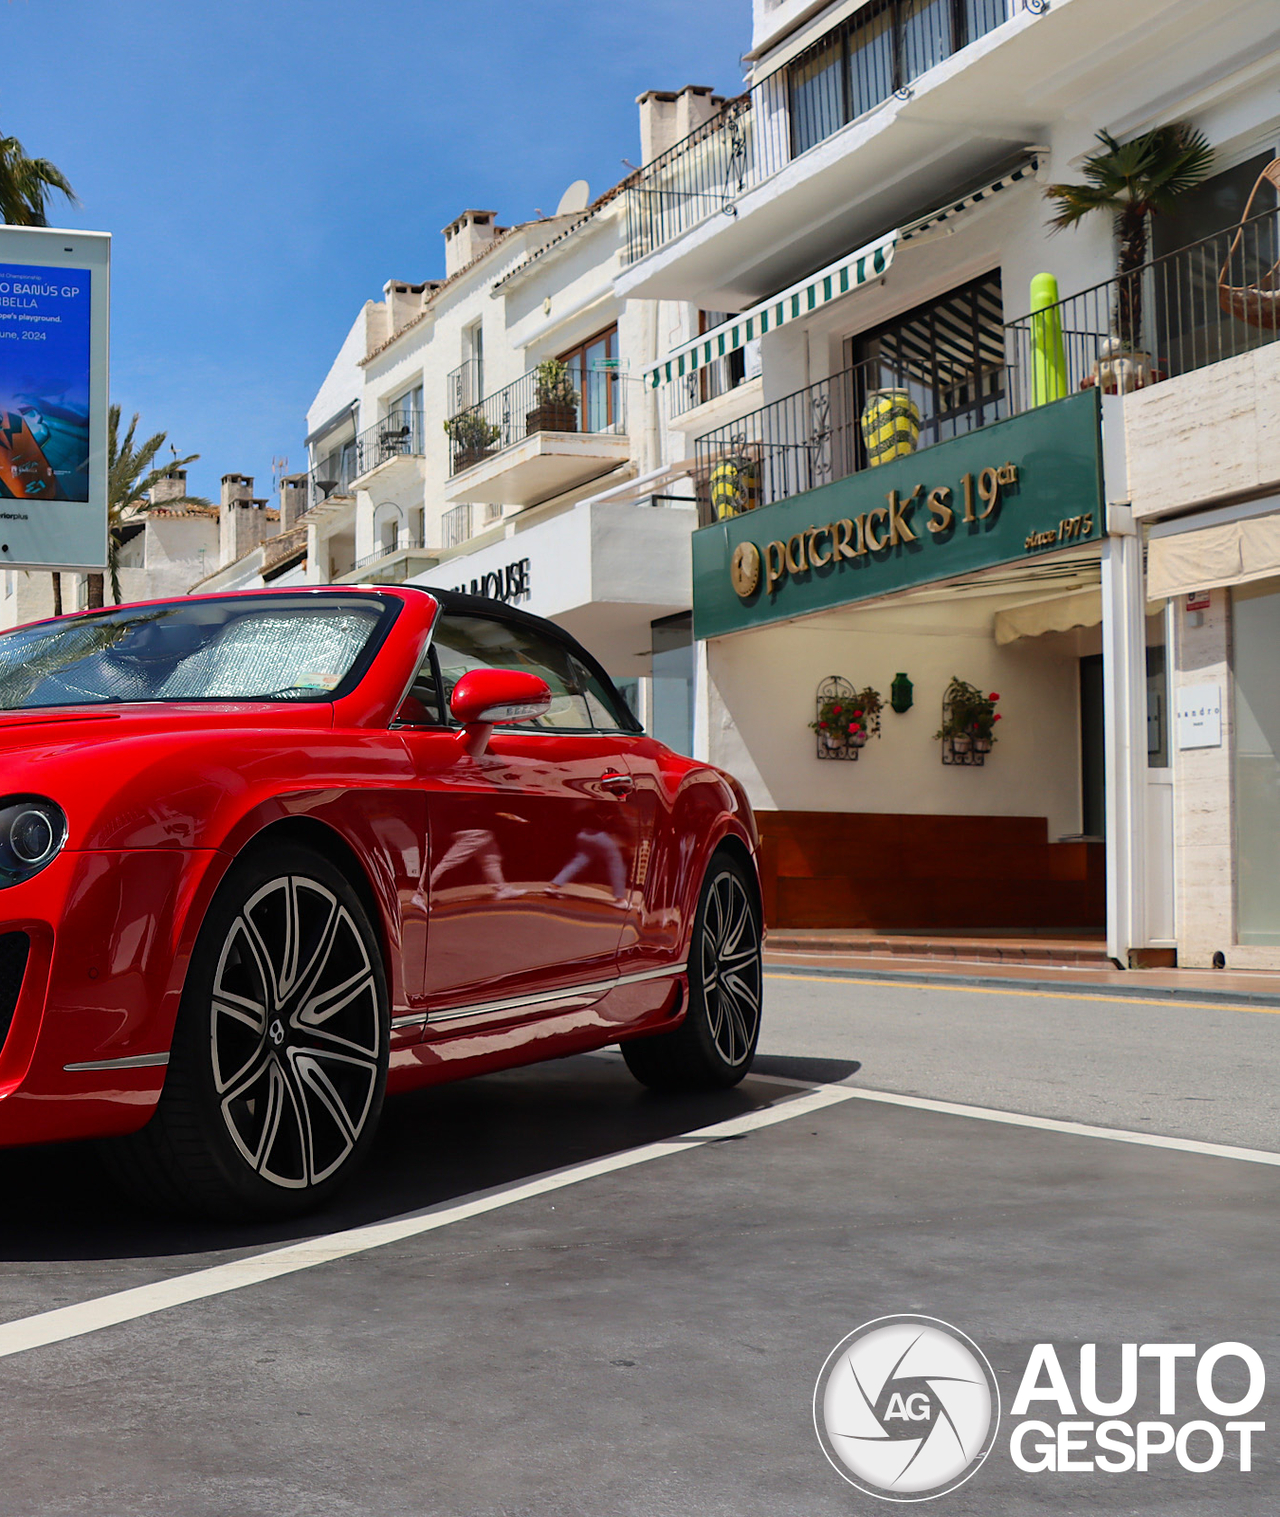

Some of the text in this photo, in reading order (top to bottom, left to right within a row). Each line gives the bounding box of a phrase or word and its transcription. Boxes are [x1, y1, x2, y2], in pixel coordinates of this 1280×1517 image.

[6, 273, 42, 281] Championship
[13, 282, 58, 297] BANÚS
[61, 286, 80, 298] GP
[18, 313, 62, 323] playground.
[21, 331, 46, 341] 2024
[1024, 513, 1094, 549] since 1975
[1177, 707, 1220, 718] sandro
